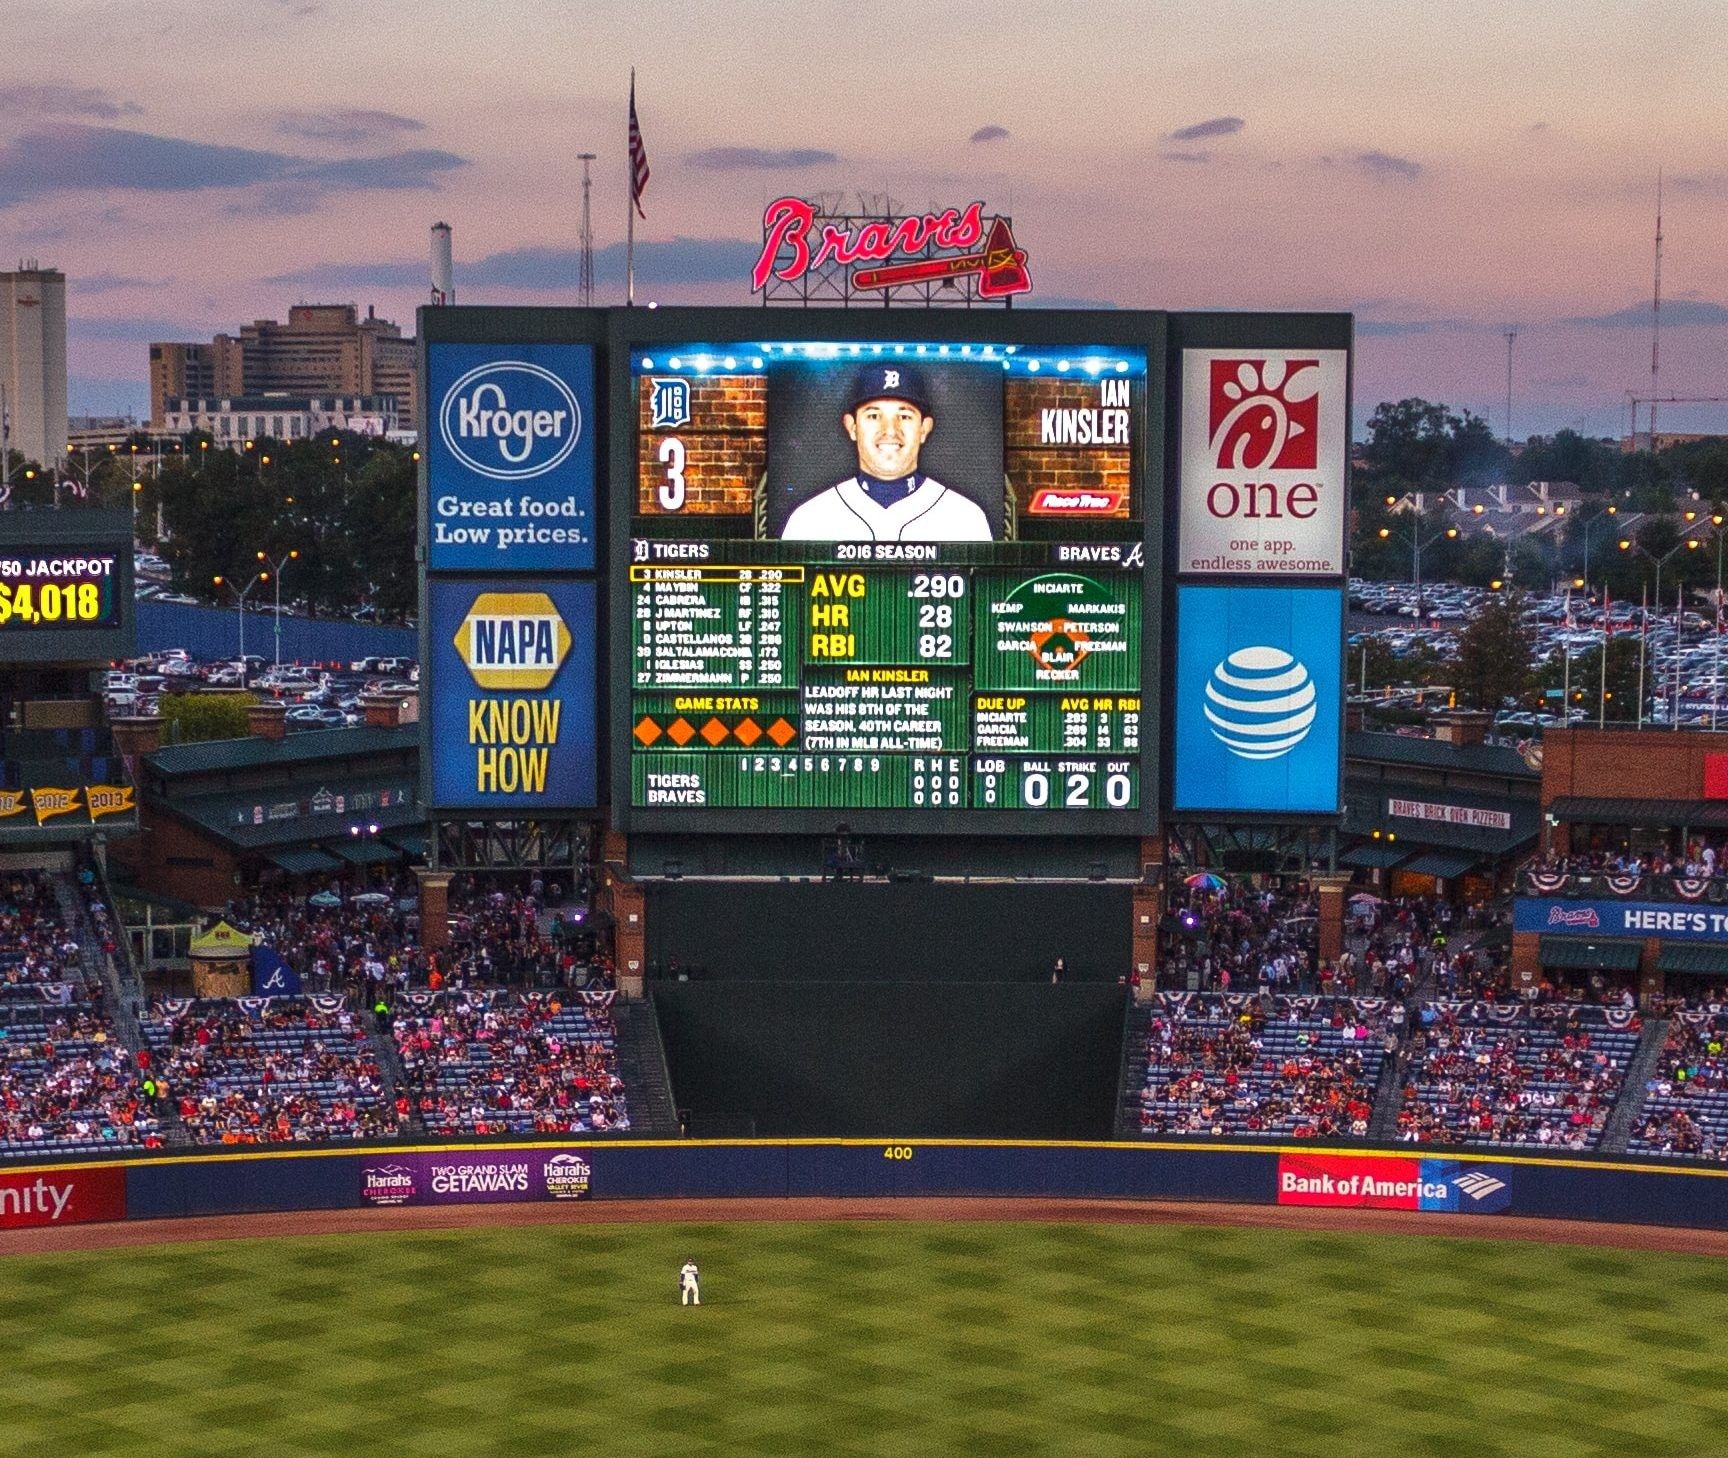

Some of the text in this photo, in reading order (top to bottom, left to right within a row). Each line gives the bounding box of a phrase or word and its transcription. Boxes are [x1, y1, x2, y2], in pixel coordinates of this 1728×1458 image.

[751, 197, 985, 293] Braves
[1101, 380, 1129, 407] IAN
[459, 383, 566, 462] Kroger
[1041, 408, 1129, 444] KINSLER
[658, 437, 686, 510] 3
[437, 496, 585, 517] Great food.
[1206, 482, 1318, 519] one
[435, 523, 588, 549] Low prices.
[653, 544, 709, 558] TIGERS
[837, 545, 936, 559] 2016 SEASON
[1059, 546, 1121, 560] BRAVES
[1230, 540, 1296, 554] one app.
[25, 559, 113, 576] JACKPOT
[1191, 557, 1334, 571] endless awesome.
[811, 574, 964, 598] AVG .290
[812, 604, 952, 627] HR 28
[476, 620, 553, 664] NAPA
[812, 634, 952, 658] RBI 82
[847, 670, 929, 682] IAN KINSLER
[805, 686, 953, 699] LEADOFF HR LAST NIGHT
[675, 698, 758, 710] GAME STATS
[805, 703, 833, 715] WAS
[835, 703, 857, 715] HIS
[885, 704, 902, 715] OF
[904, 704, 929, 715] THE
[977, 698, 1025, 710] DUE UP
[469, 699, 560, 744] KNOW
[805, 720, 942, 732] SEASON, 40TH CAREER
[805, 737, 943, 751] (7TH IN MLB ALL-TIME)
[478, 747, 548, 792] HOW
[1024, 762, 1129, 772] BALL STRIKE OUT
[648, 775, 700, 787] TIGERS
[648, 790, 706, 803] BRAVES
[1024, 774, 1130, 806] 0 2 0
[92, 791, 126, 808] 2013
[1624, 909, 1708, 932] HERE'S
[884, 1147, 912, 1160] 400
[431, 1163, 528, 1177] TWO GRAND SLAM
[431, 1174, 528, 1193] GETAWAYS
[1282, 1172, 1447, 1198] Bank of America
